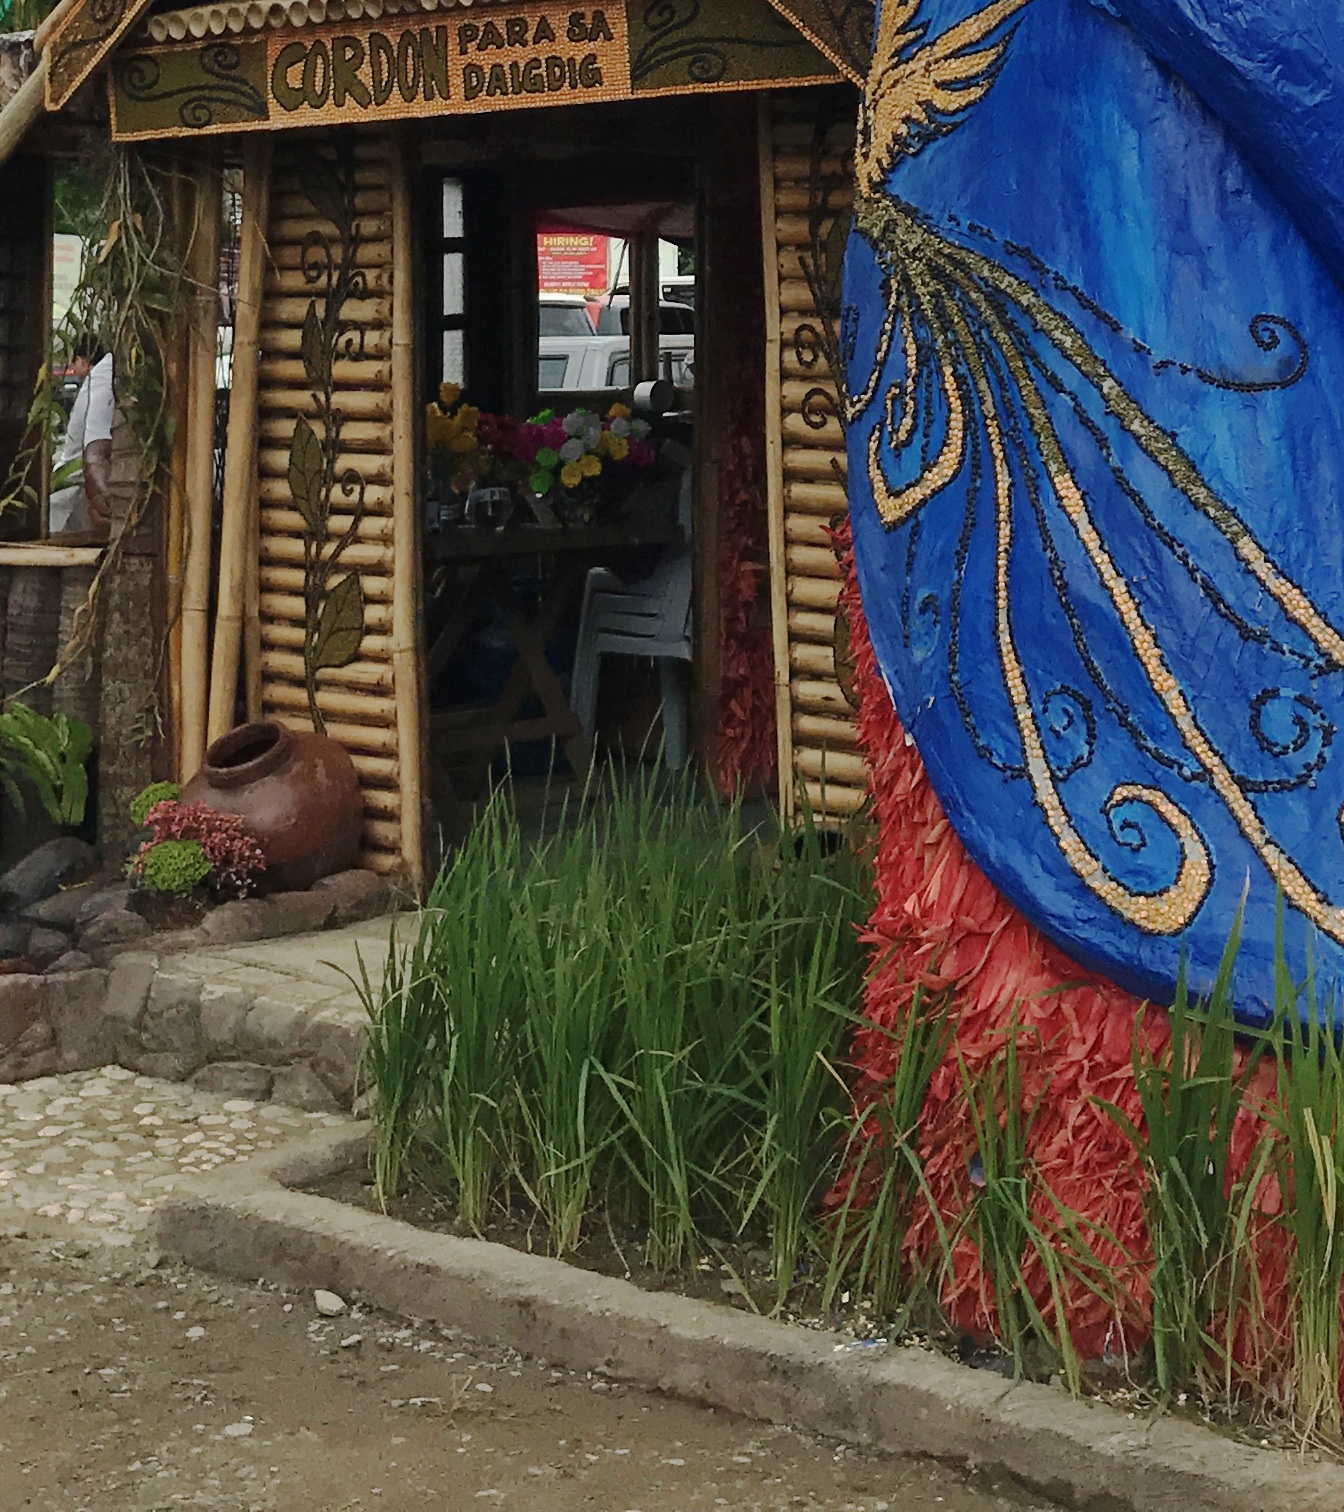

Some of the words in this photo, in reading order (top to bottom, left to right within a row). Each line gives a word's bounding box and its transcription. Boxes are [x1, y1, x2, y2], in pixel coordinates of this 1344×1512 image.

[457, 15, 556, 56] PARA
[567, 9, 614, 43] SA
[272, 26, 449, 110] CORDON
[462, 52, 604, 102] DAIGDIG
